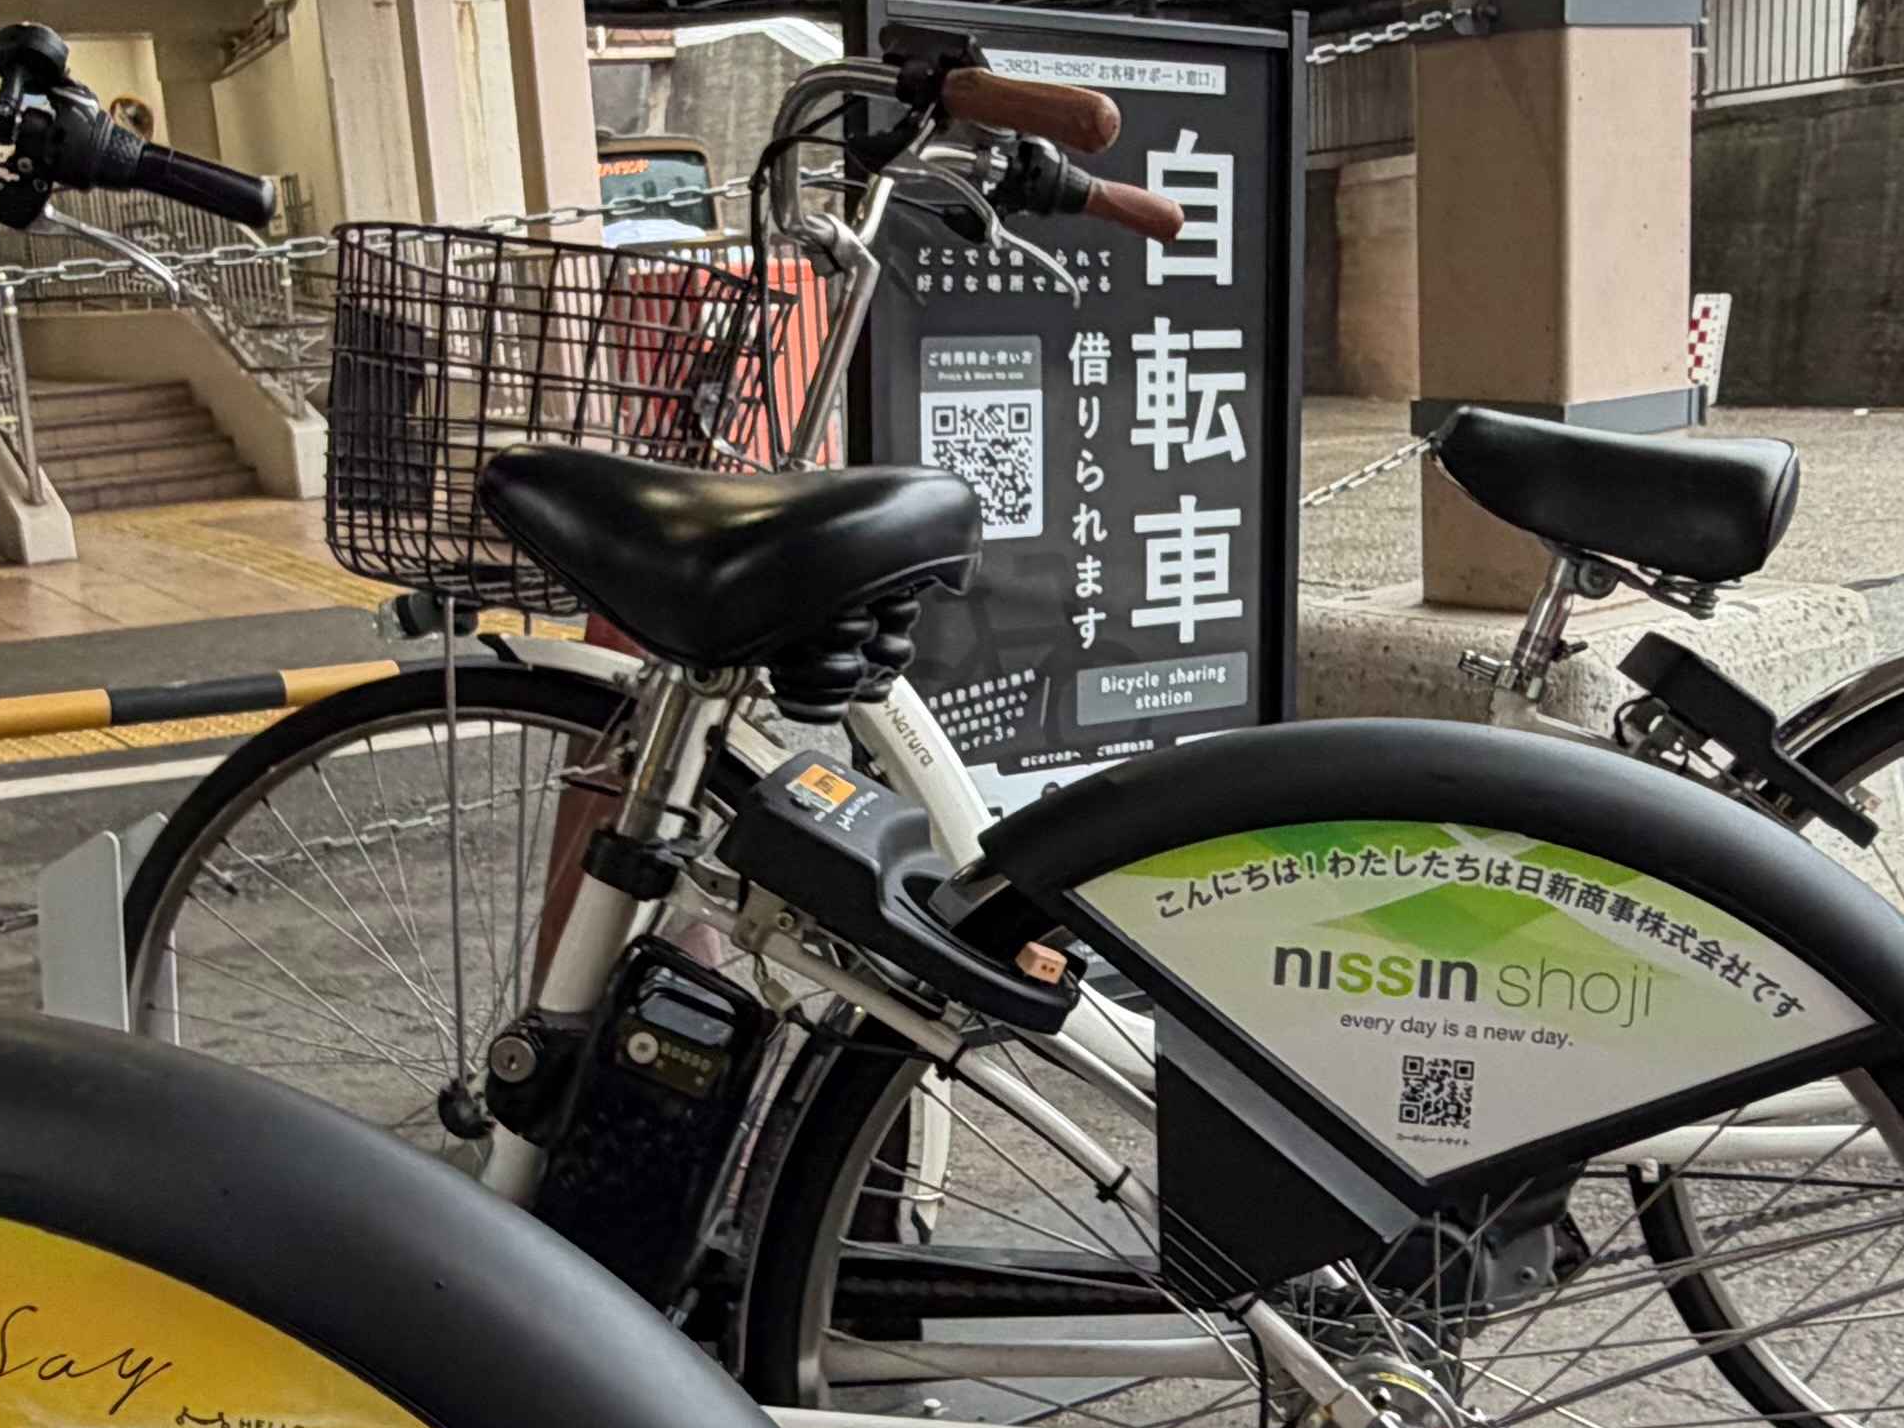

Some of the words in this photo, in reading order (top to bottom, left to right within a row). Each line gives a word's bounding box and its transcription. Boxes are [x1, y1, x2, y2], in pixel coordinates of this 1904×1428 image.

[1130, 128, 1247, 644] 自転車
[1068, 331, 1112, 650] 借りられます
[1101, 671, 1161, 695] Bicycle
[1168, 664, 1227, 685] sharing
[1135, 690, 1194, 711] station
[889, 704, 935, 768] Natura
[1273, 945, 1477, 1003] nissin
[1496, 957, 1653, 1028] shoji
[1339, 1013, 1394, 1036] every
[1400, 1014, 1438, 1039] day
[1443, 1018, 1459, 1037] is
[1465, 1025, 1476, 1039] a
[1483, 1025, 1526, 1042] new
[1531, 1025, 1574, 1049] day.
